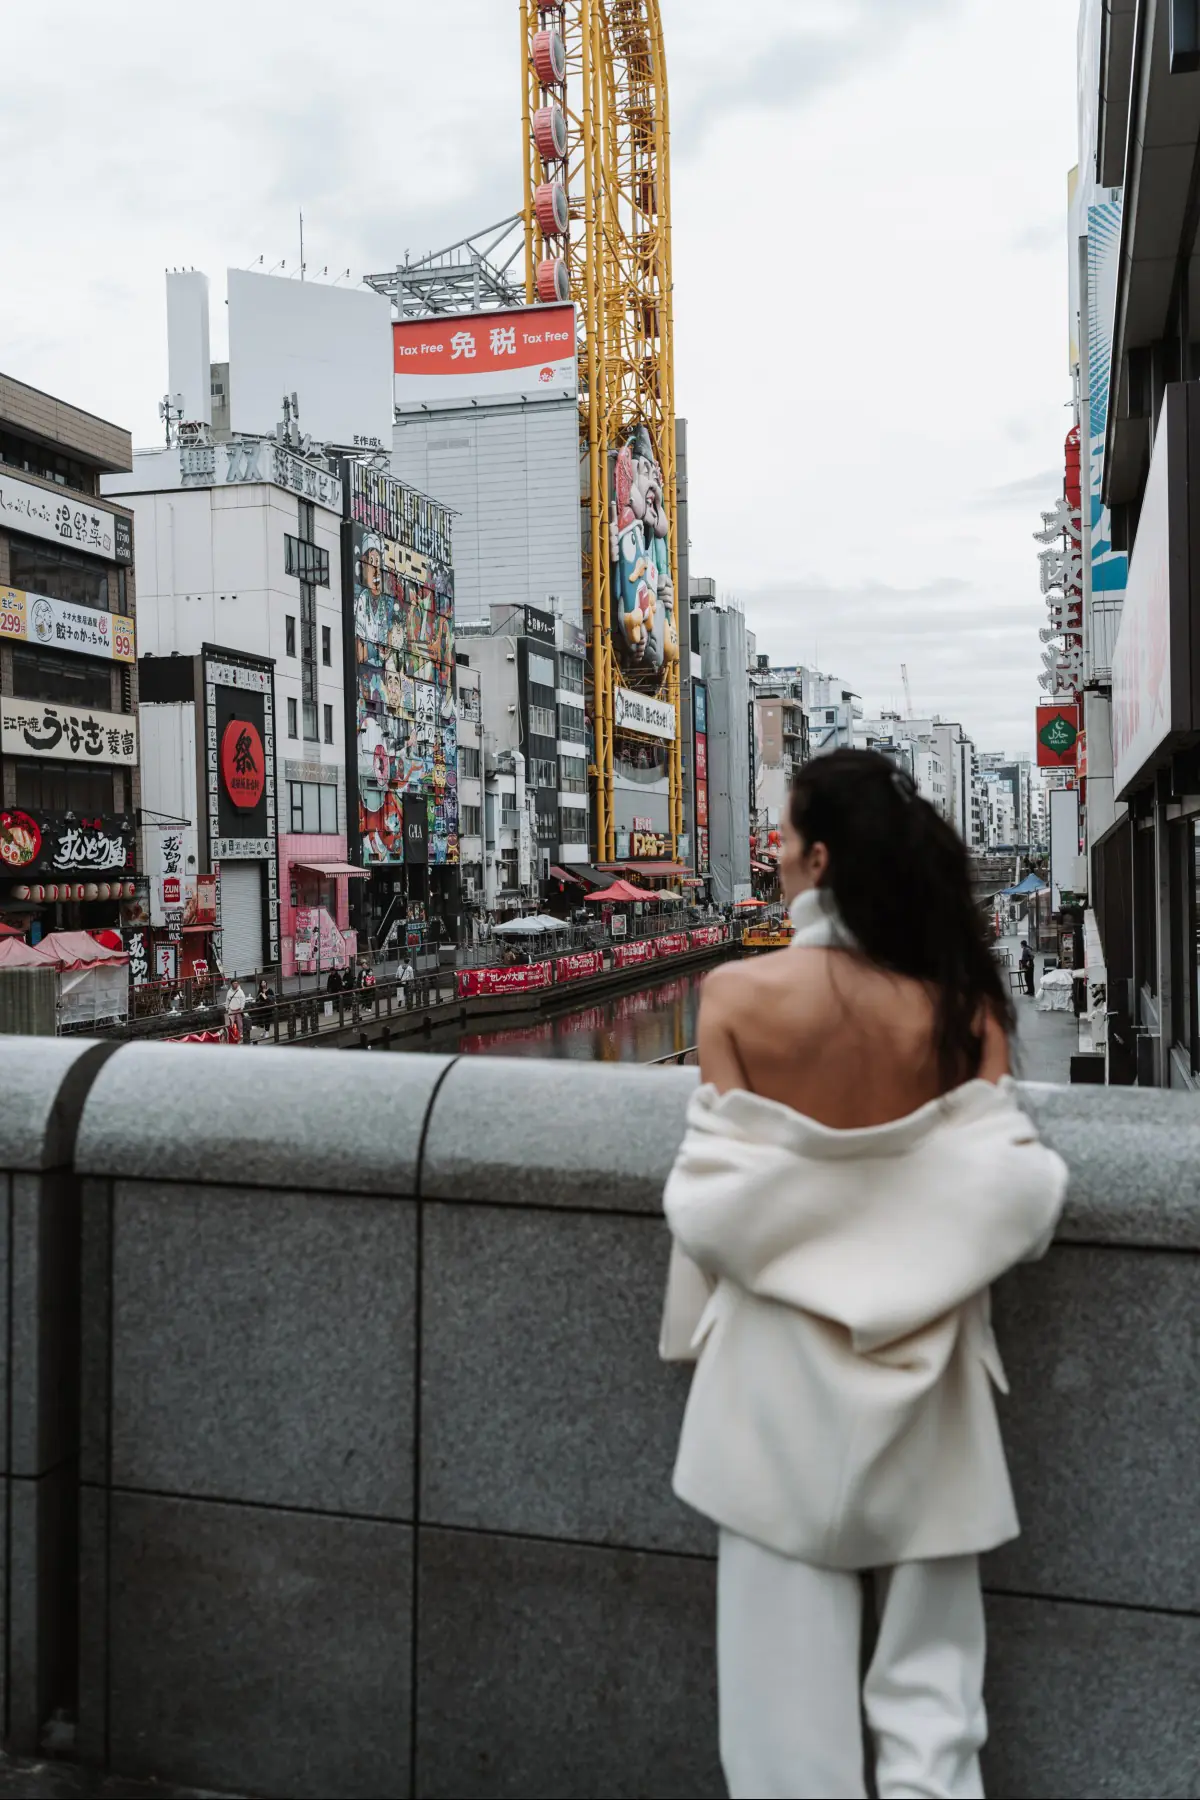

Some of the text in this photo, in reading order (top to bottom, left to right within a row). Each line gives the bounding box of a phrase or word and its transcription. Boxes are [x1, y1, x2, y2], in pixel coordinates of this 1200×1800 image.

[450, 326, 517, 360] 免税
[523, 331, 569, 343] Tax Free
[400, 343, 444, 355] Tax Free
[0, 612, 21, 633] 299
[55, 622, 110, 647] 餃子のかっちゃん
[115, 635, 130, 656] 99
[4, 707, 134, 756] 江戸焼 うなぎ 菱富
[164, 885, 180, 894] ZUN
